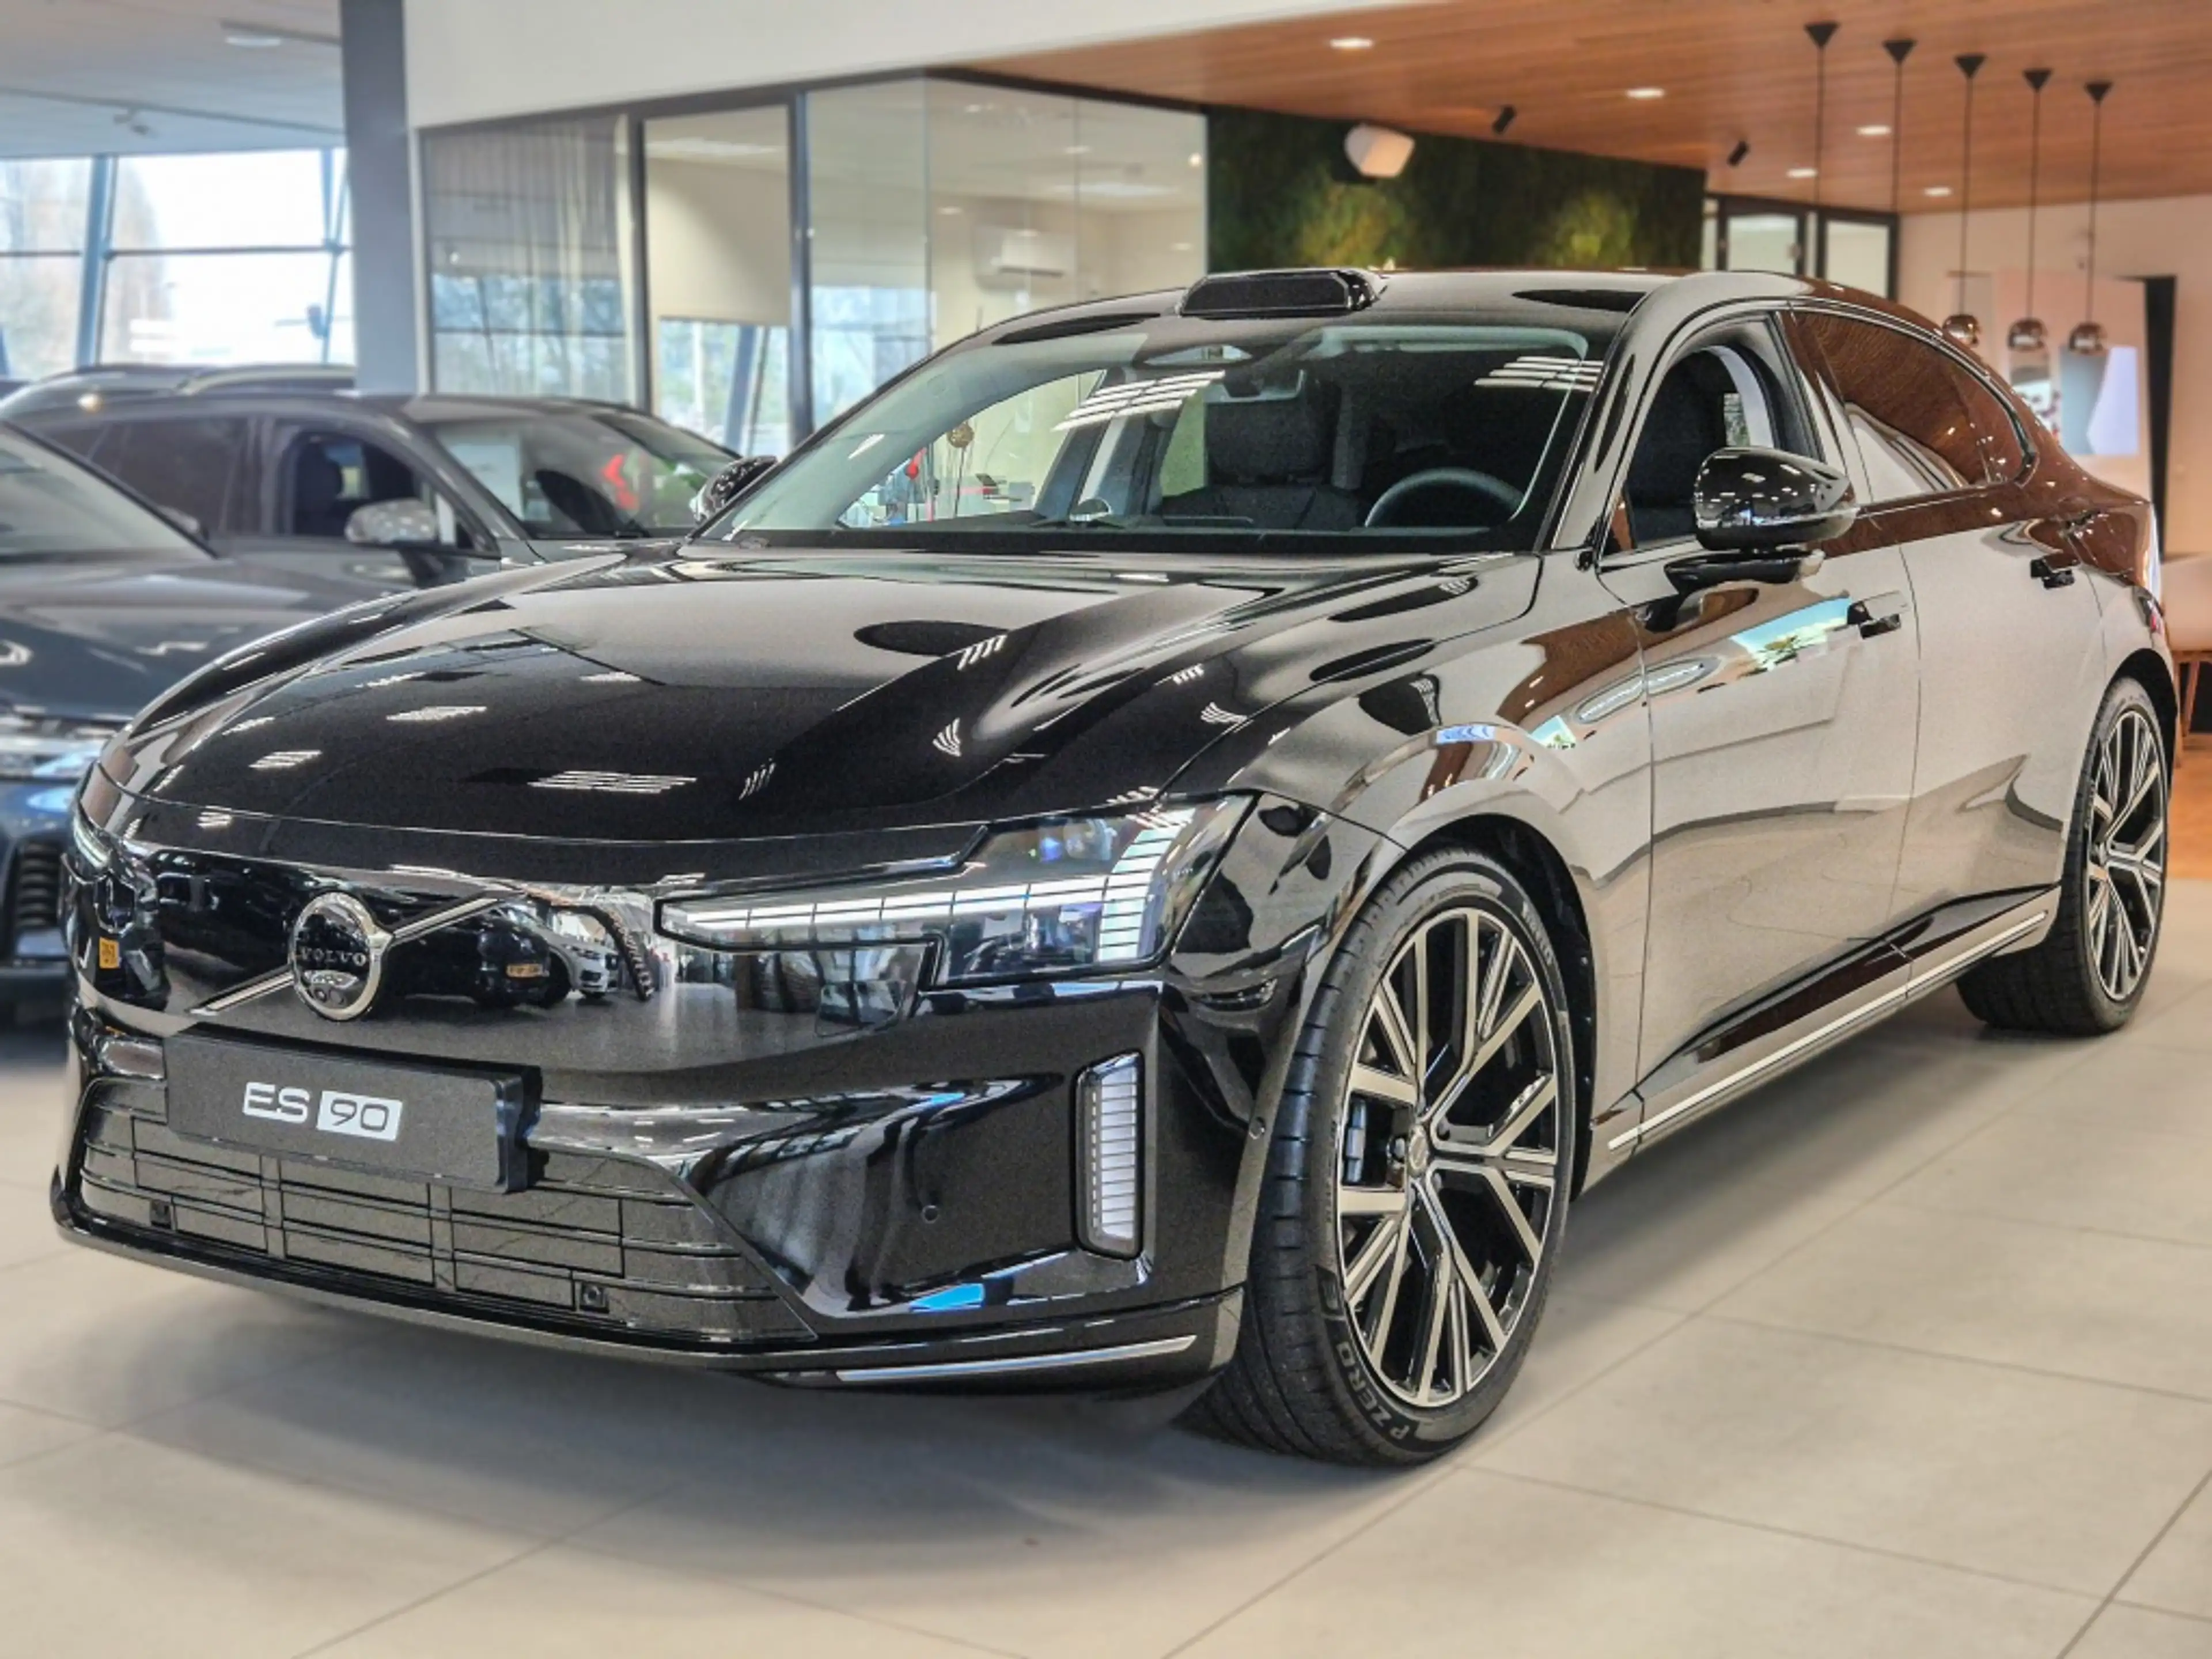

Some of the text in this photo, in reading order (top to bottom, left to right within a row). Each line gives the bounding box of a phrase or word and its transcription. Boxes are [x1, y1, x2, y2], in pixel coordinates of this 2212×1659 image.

[300, 948, 367, 967] VOLVO
[243, 1082, 391, 1133] ES 90
[1336, 1341, 1393, 1427] ZERO
